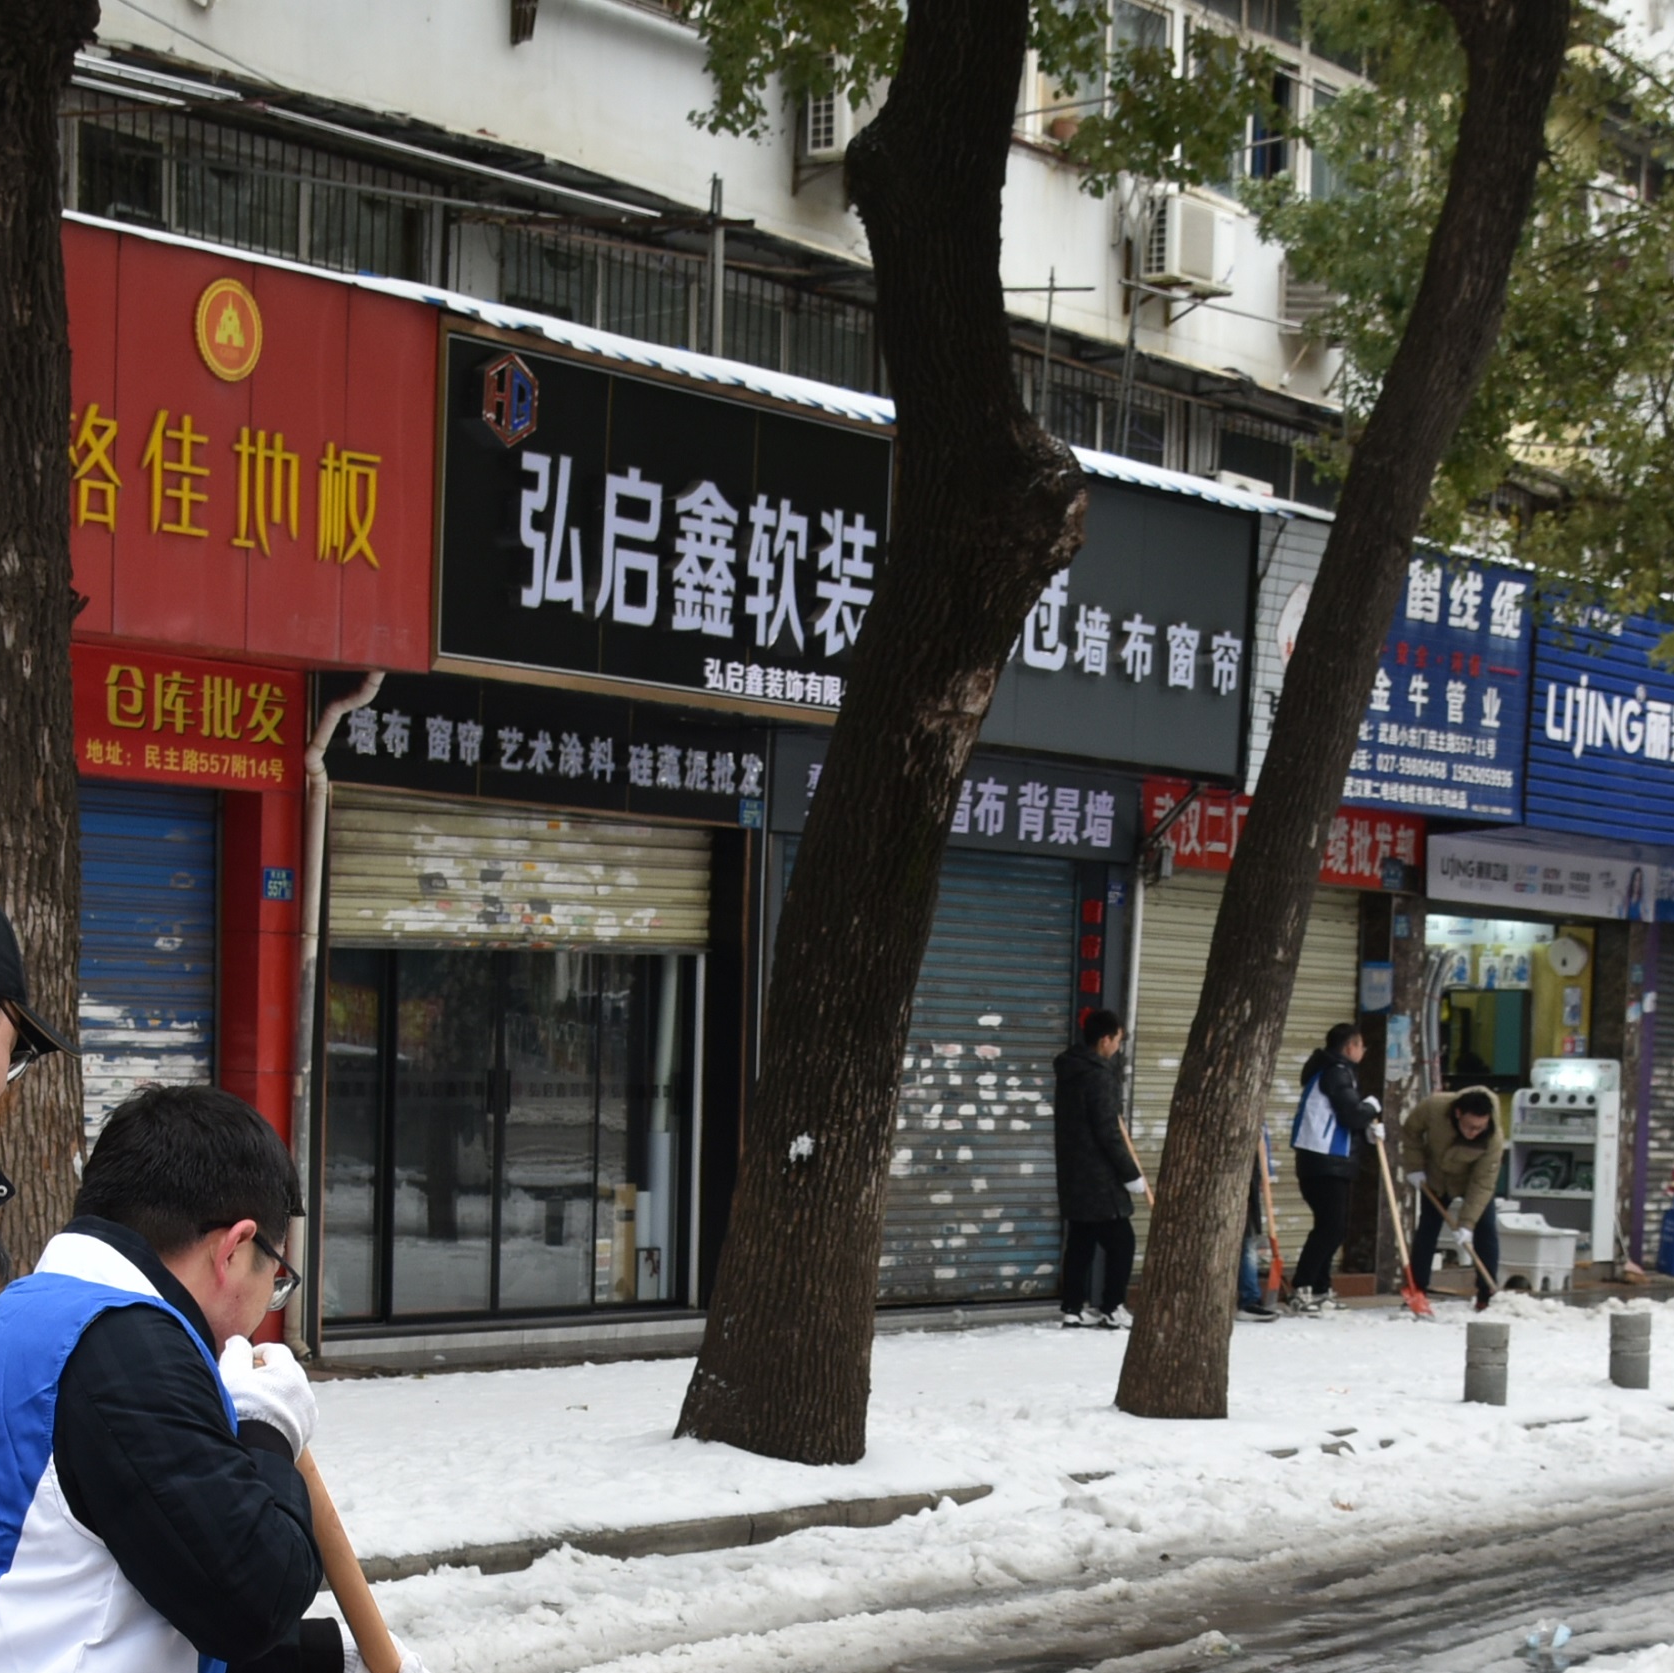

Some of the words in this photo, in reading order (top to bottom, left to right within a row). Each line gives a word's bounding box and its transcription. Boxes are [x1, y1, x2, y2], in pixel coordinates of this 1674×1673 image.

[520, 448, 878, 660] 弘启鑫软装
[703, 657, 848, 708] 弘启鑫装饰有限
[1074, 604, 1243, 697] 墙布窗帘
[104, 664, 288, 746] 仓库批发
[1369, 667, 1502, 729] 金牛管业
[347, 705, 413, 758] 墙布
[426, 713, 485, 766] 窗帘
[497, 726, 617, 783] 艺术涂料
[627, 742, 764, 797] 硅藻泥批发
[1016, 781, 1115, 849] 背景墙
